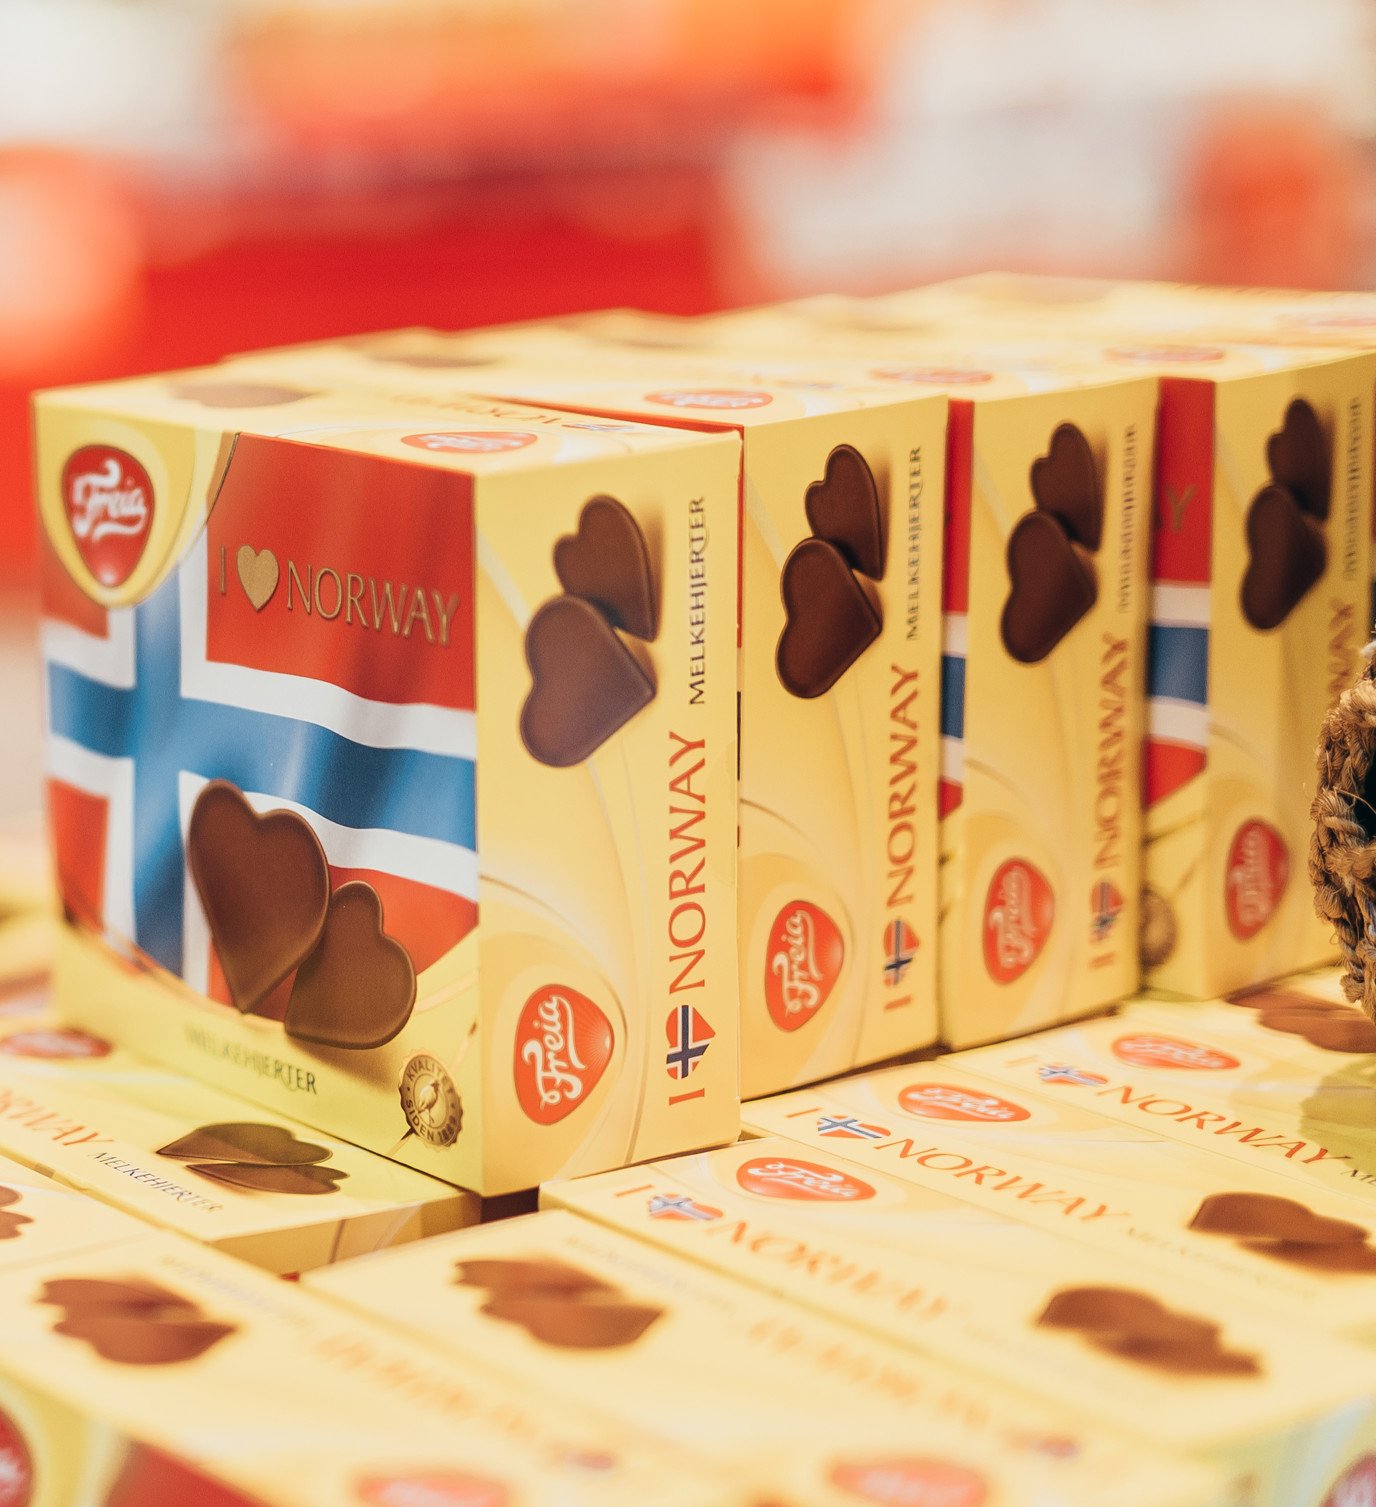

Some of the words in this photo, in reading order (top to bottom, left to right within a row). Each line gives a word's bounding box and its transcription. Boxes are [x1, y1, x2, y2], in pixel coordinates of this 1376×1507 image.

[72, 459, 148, 542] Freia
[286, 559, 460, 647] NORWAY
[669, 731, 707, 995] NORWAY
[688, 495, 710, 706] MELKEHJERTER
[886, 663, 921, 910] NORWAY
[772, 909, 823, 1018] Freia
[521, 994, 587, 1110] Freia
[406, 1099, 435, 1142] SIDEN
[1095, 1085, 1353, 1164] NORWAY
[874, 1137, 1129, 1223] NORWAY
